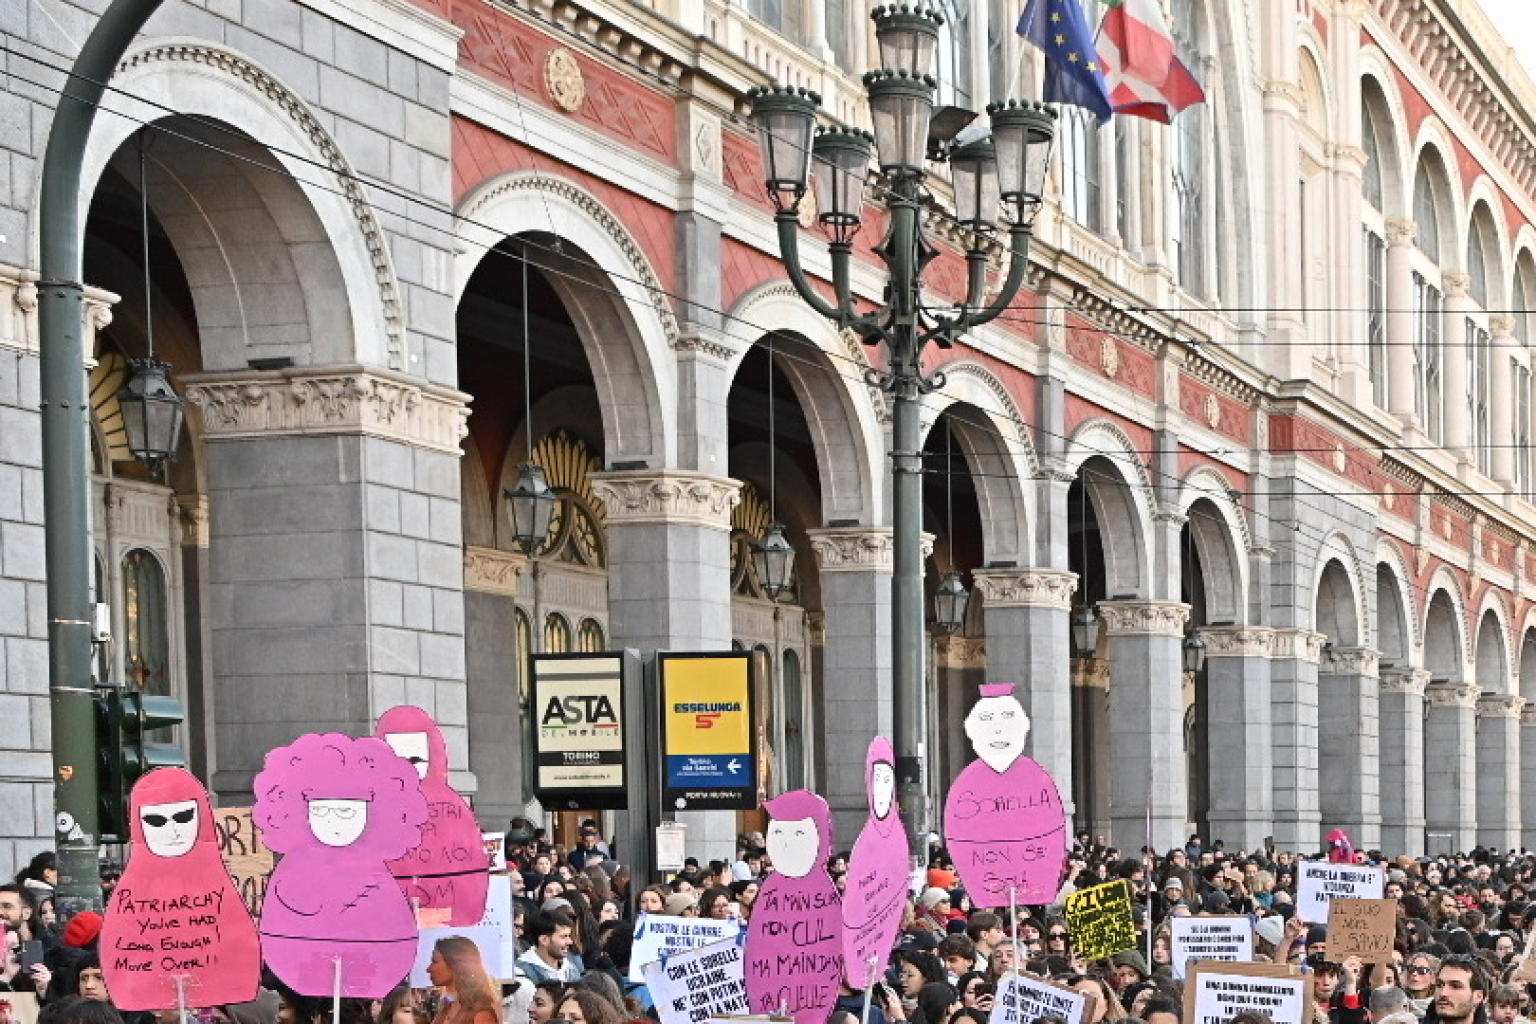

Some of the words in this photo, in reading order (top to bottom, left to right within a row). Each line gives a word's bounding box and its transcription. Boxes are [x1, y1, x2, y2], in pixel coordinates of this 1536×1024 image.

[542, 695, 617, 725] ASTA
[673, 702, 742, 714] ESSELUNGA
[562, 751, 600, 760] TORINO
[953, 787, 1052, 820] SORELLA
[972, 847, 1011, 867] NON
[1306, 868, 1328, 880] ANCHE
[116, 886, 225, 915] PATRIARCHY
[189, 914, 217, 926] HAD
[792, 917, 835, 947] CUL
[667, 963, 688, 981] CON
[688, 959, 701, 975] LE
[700, 947, 740, 971] SORELLE
[776, 951, 816, 976] MAIN
[689, 989, 710, 1008] CON
[709, 980, 740, 1001] PUTIN
[689, 1006, 710, 1023] CON
